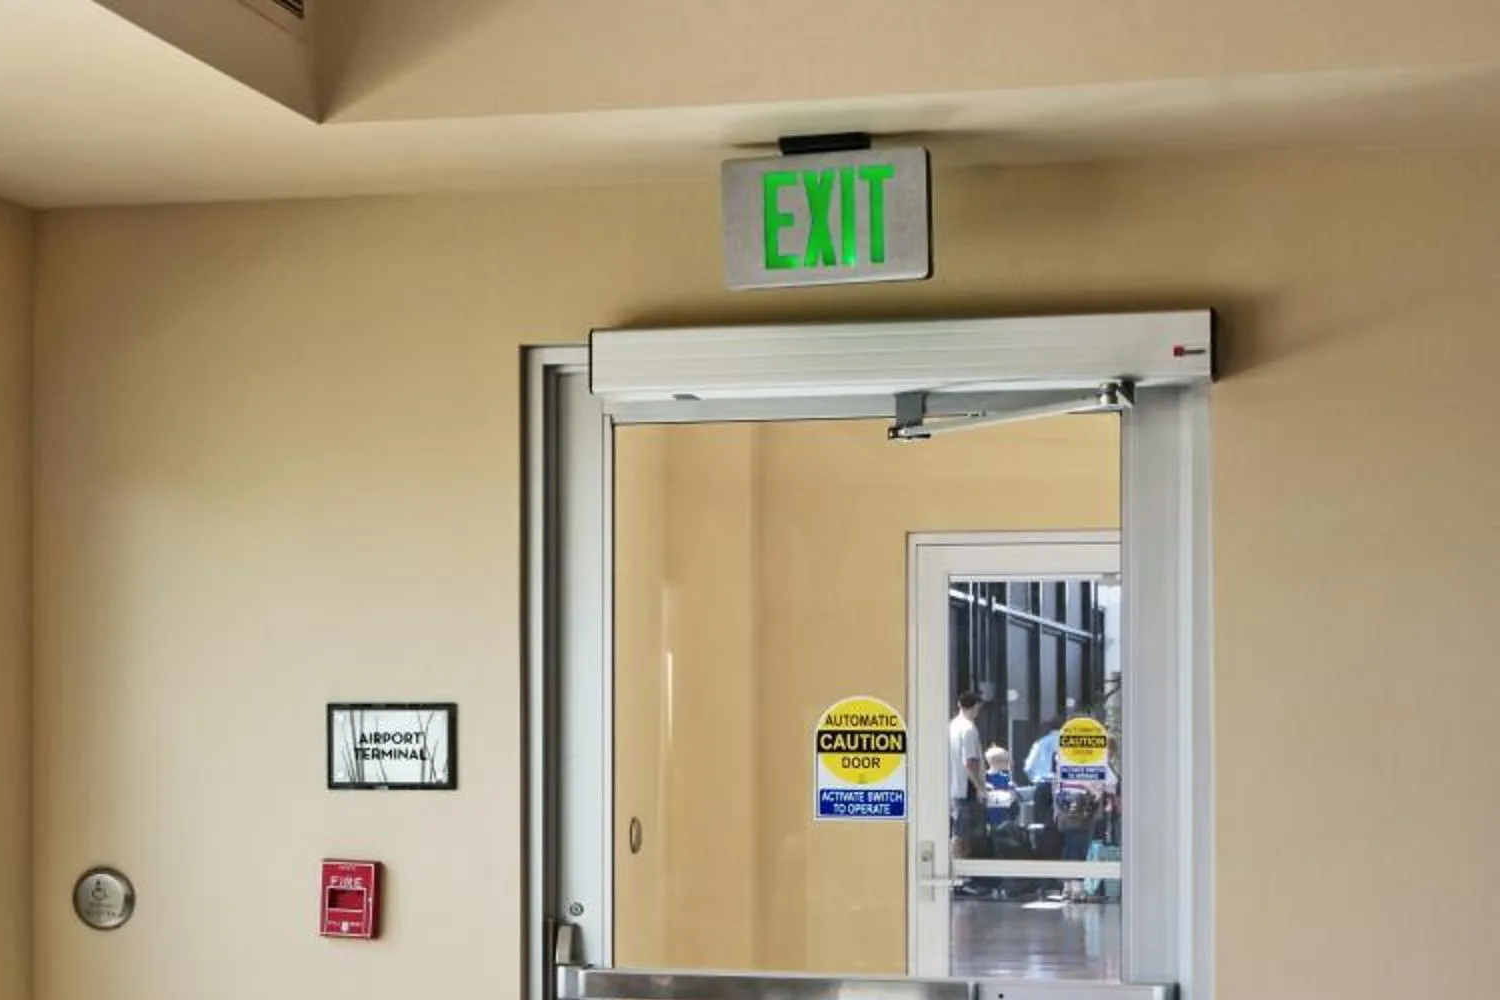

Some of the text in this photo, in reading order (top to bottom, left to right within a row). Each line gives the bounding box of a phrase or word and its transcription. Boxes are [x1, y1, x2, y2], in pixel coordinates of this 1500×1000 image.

[762, 164, 895, 270] EXIT
[825, 714, 898, 727] AUTOMATIC
[359, 731, 424, 745] AIRPORT
[820, 733, 902, 751] CAUTION
[355, 747, 427, 761] TERMINAL
[841, 756, 881, 769] DOOR
[822, 791, 902, 802] ACTIVATE SWITCH
[833, 803, 891, 815] TO OPERATE
[330, 875, 364, 889] FIRE
